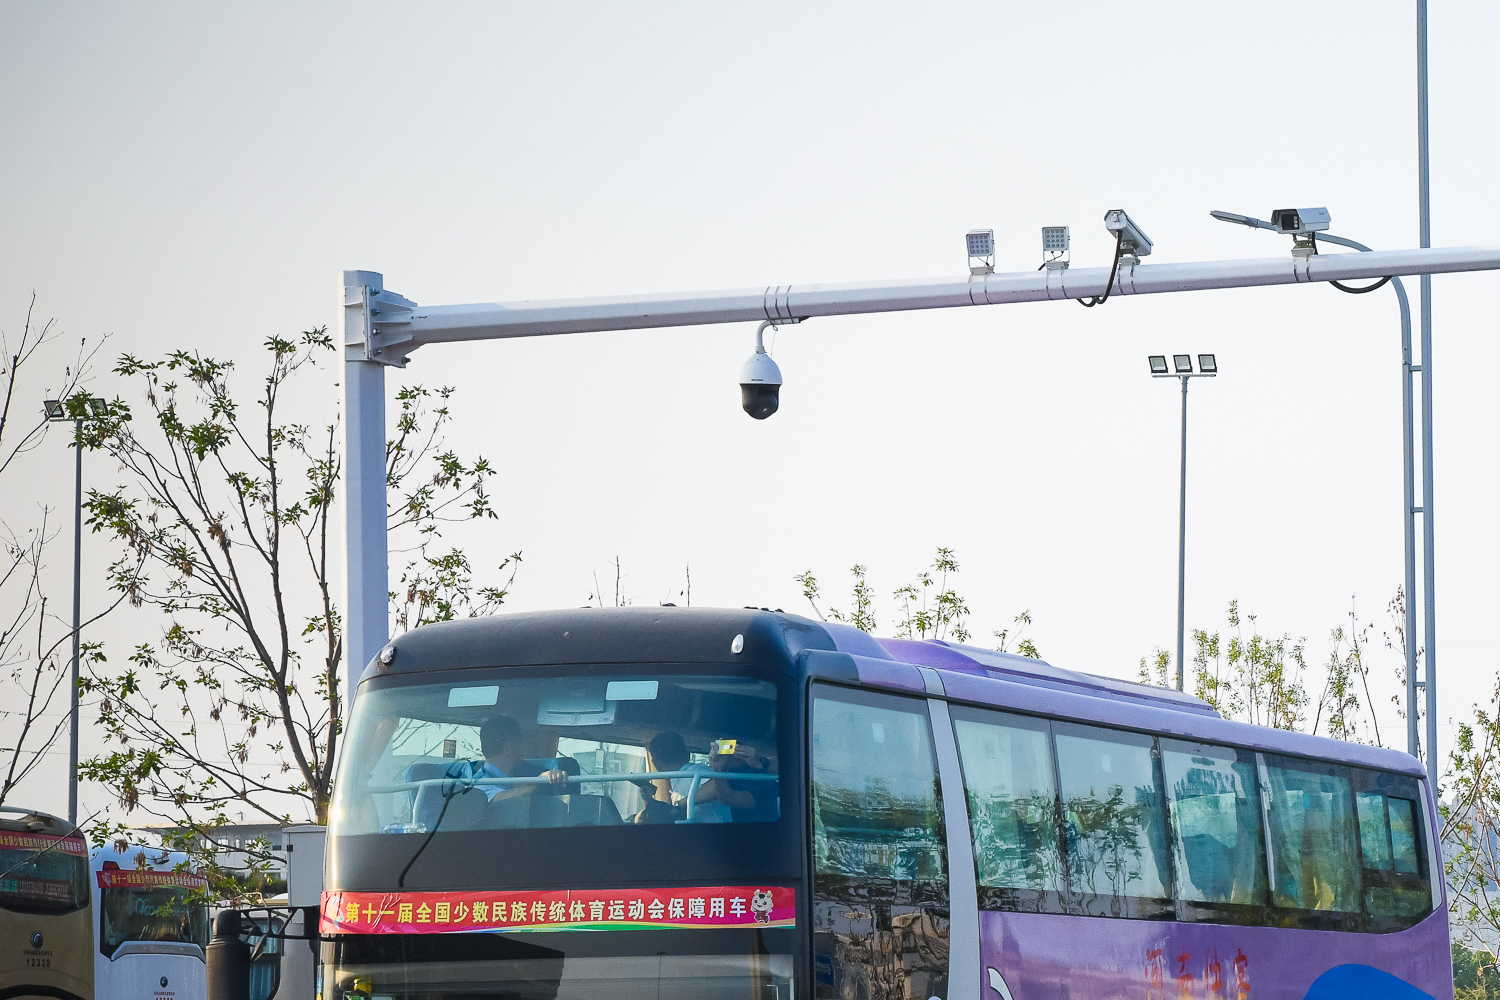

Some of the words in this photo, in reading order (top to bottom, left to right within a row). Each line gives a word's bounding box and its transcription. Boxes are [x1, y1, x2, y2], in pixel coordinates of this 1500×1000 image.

[345, 896, 747, 924] 第十一届全国少数民族传统体育运动会保障用车
[26, 957, 51, 968] 12328
